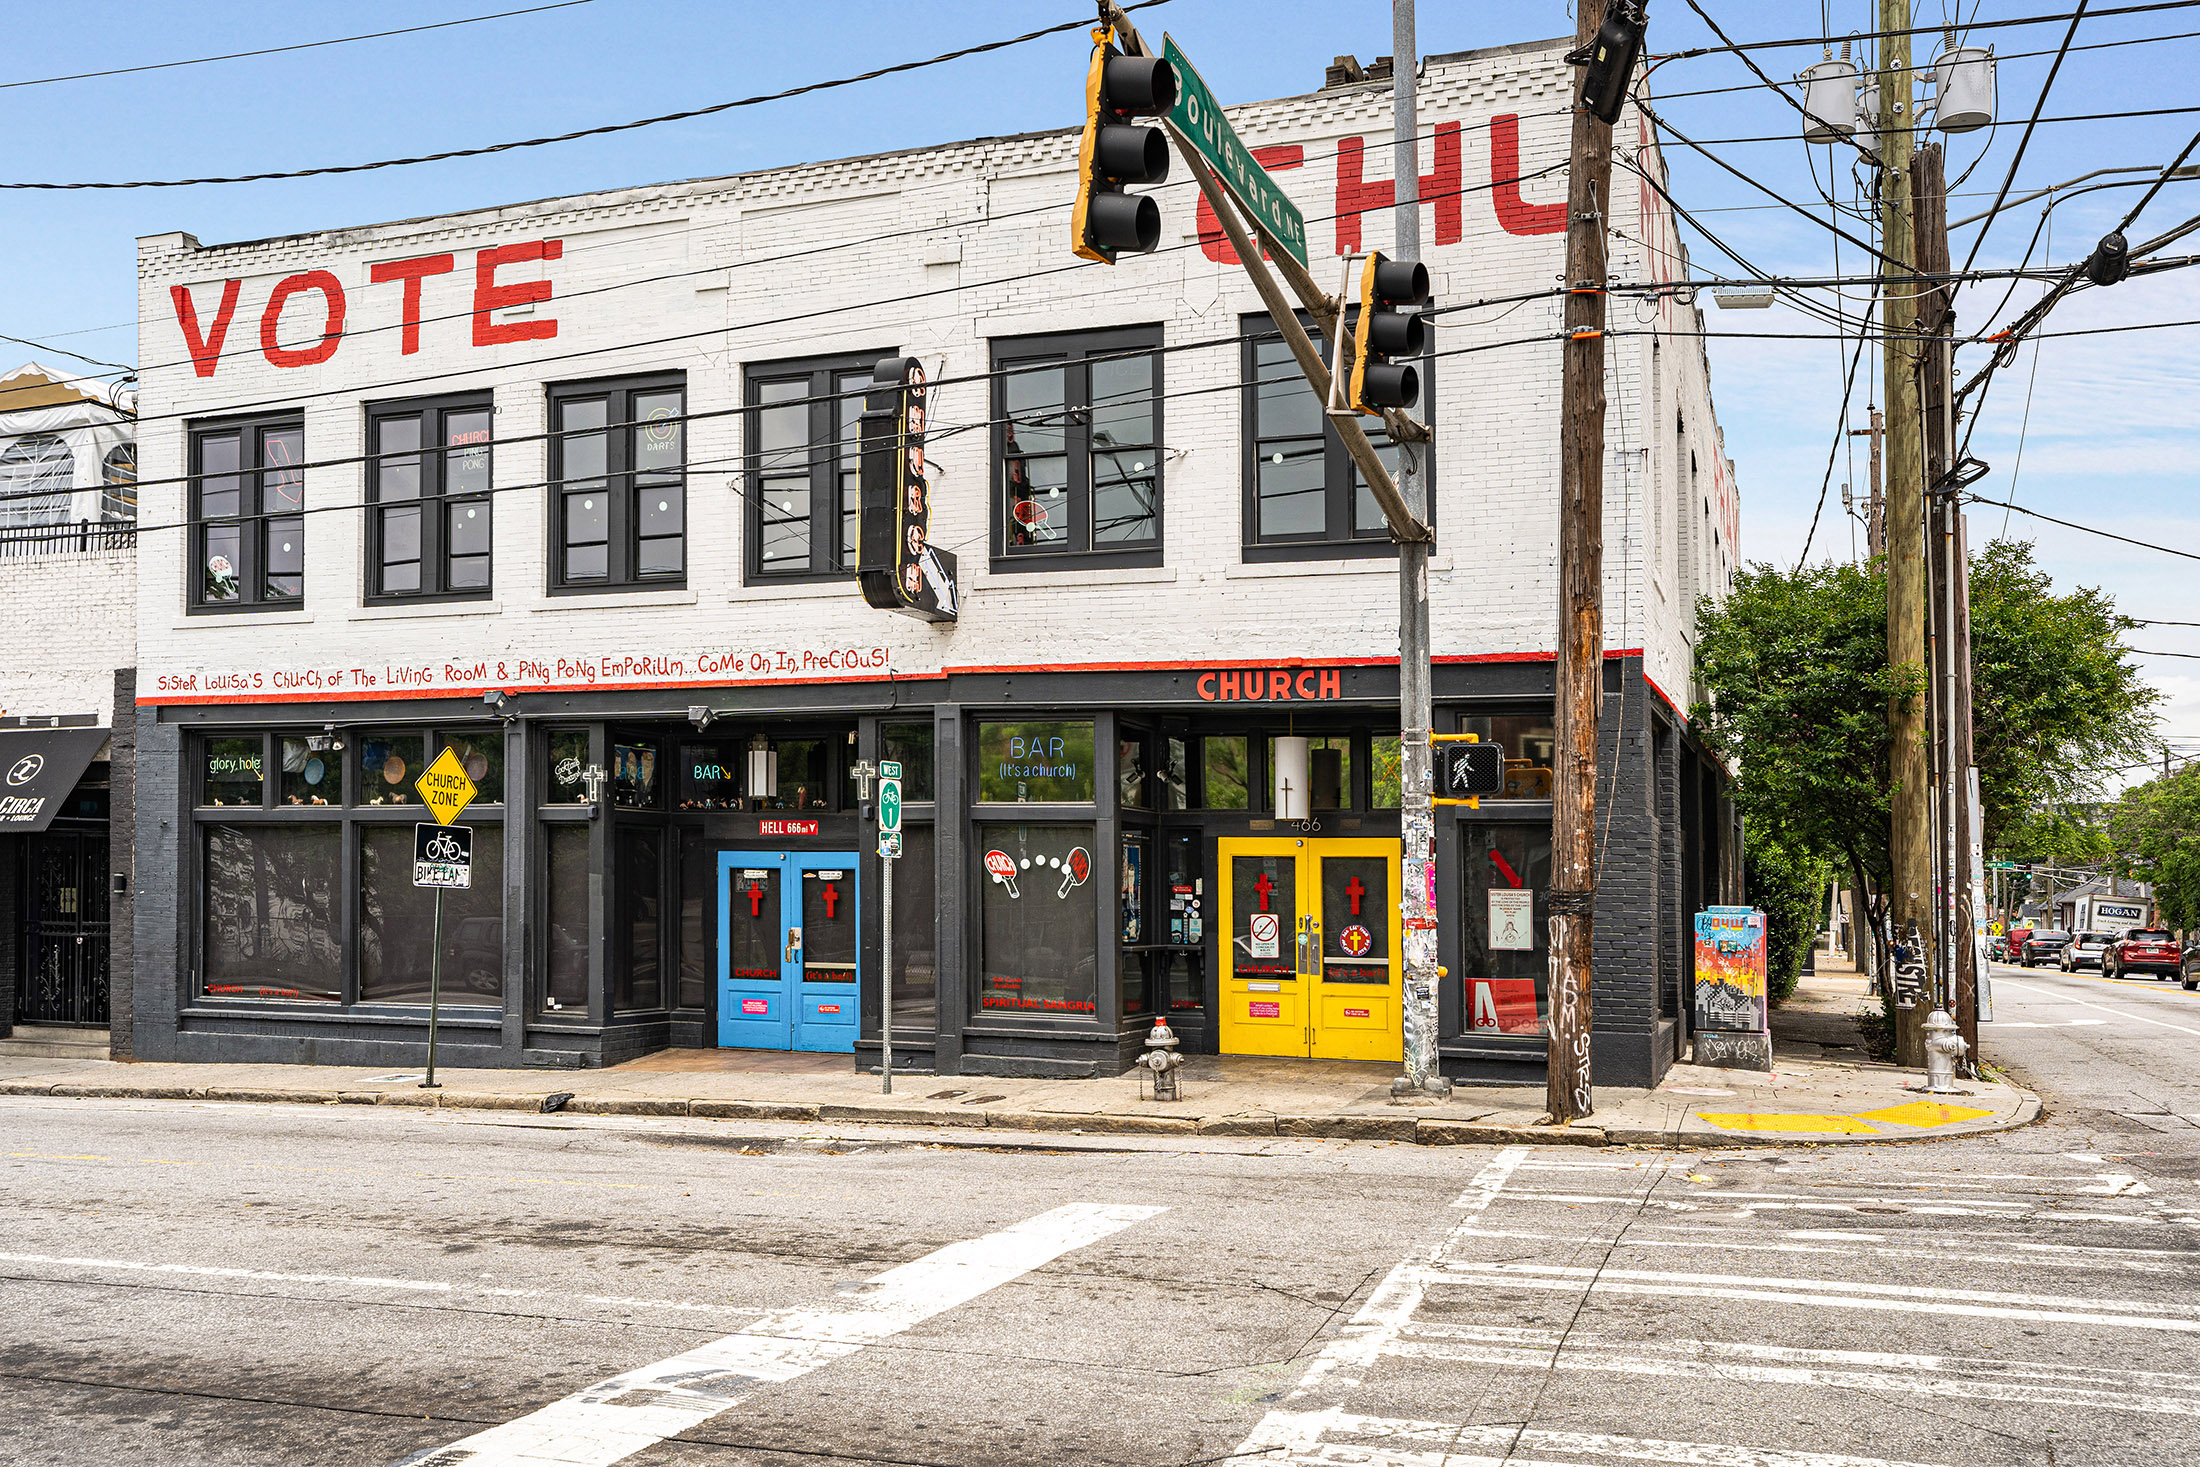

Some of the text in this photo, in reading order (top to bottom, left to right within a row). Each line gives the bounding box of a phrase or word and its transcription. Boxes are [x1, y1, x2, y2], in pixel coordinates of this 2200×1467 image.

[1170, 62, 1302, 248] Boulevard NE
[170, 239, 562, 377] VOTE
[647, 441, 675, 451] DARTS
[351, 668, 377, 687] The
[498, 662, 509, 680] &
[1197, 670, 1341, 701] CHURCH
[1010, 736, 1065, 759] BAR
[239, 756, 261, 770] hole
[1023, 766, 1030, 777] a
[1031, 762, 1076, 780] church)
[694, 764, 721, 780] BAR
[426, 772, 466, 790] CHURCH
[0, 796, 45, 814] CIRCA
[432, 790, 459, 807] ZONE
[888, 807, 893, 827] 1
[1291, 817, 1321, 832] 466
[761, 821, 784, 834] HELL
[2101, 907, 2138, 917] HOGAN
[735, 968, 777, 978] CHURCH
[1238, 964, 1289, 974] CHURCH
[207, 984, 243, 993] CHURCH
[983, 998, 1096, 1011] SPIRITUAL SANGRIA
